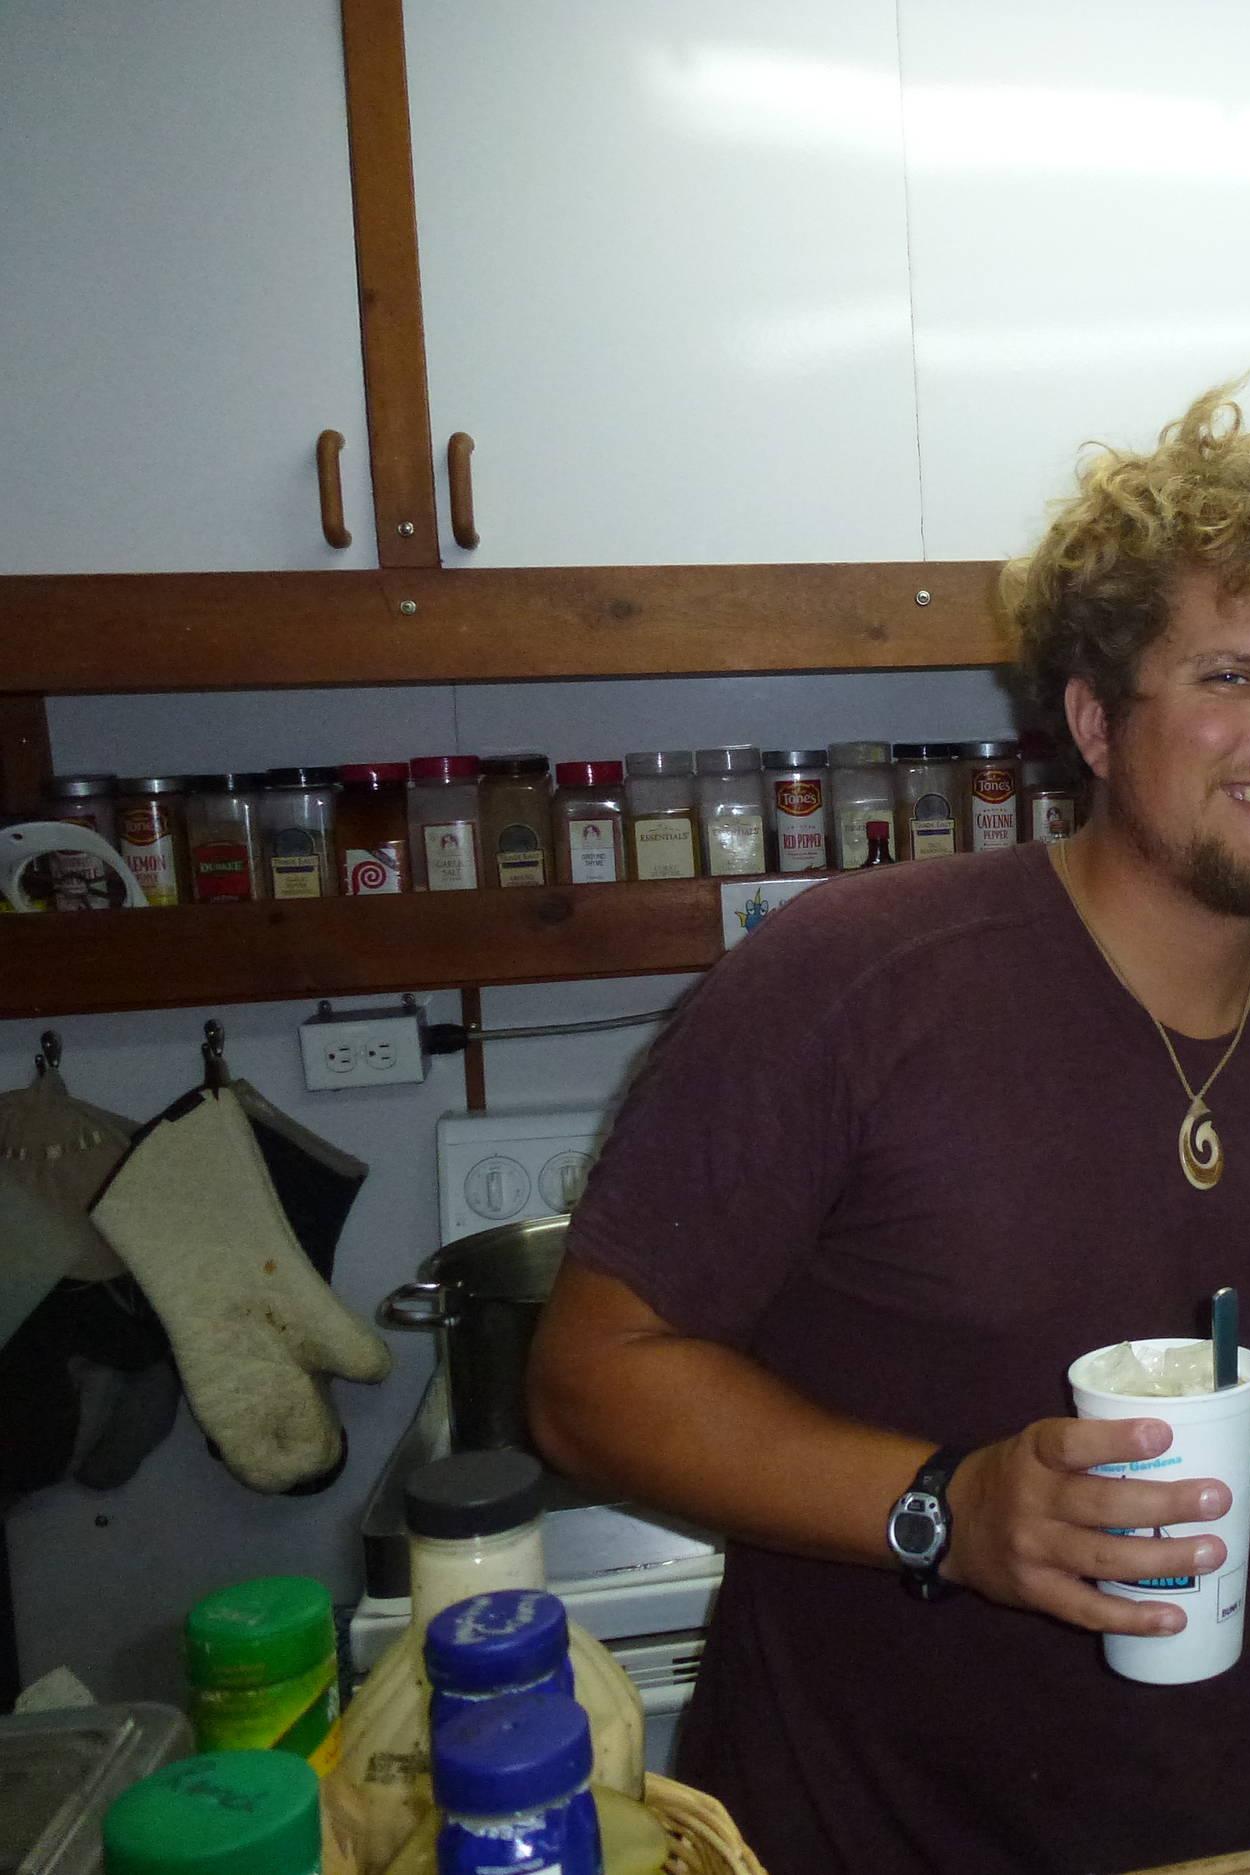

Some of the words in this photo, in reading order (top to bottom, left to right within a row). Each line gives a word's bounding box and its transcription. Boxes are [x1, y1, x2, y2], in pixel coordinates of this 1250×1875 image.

[979, 779, 1011, 791] Tone's
[783, 793, 817, 805] Tone's
[976, 814, 1013, 829] CAYENNE
[640, 832, 689, 842] ESSENTIALS
[1129, 1456, 1183, 1472] Gardens
